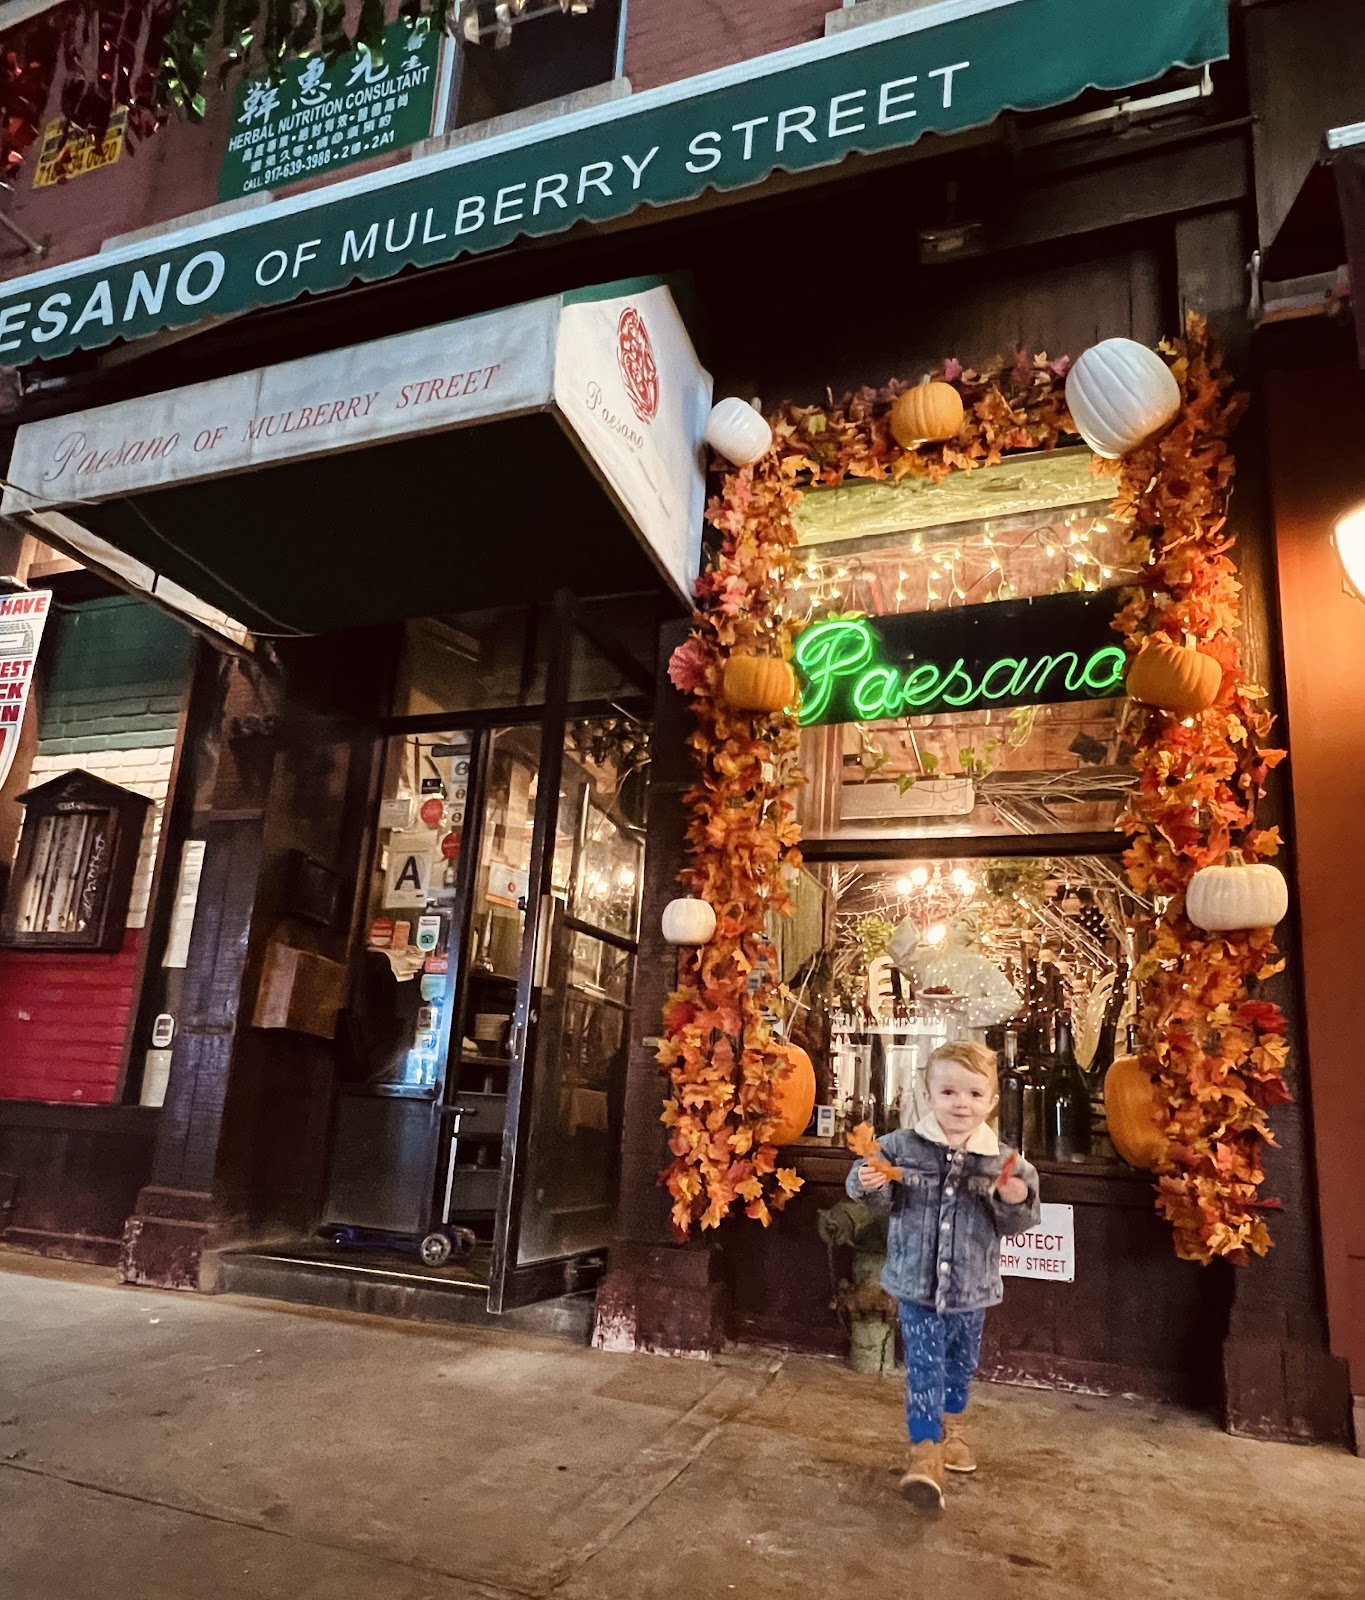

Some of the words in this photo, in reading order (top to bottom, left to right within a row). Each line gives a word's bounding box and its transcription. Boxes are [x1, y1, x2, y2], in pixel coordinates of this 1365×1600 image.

[228, 123, 275, 151] HERBAL
[277, 100, 344, 134] NUTRITION
[345, 66, 431, 111] CONSULTANT
[264, 149, 331, 185] 917-639-3988
[371, 129, 395, 149] 2A1
[0, 250, 226, 352] ESANO
[254, 239, 321, 287] OF
[339, 146, 660, 266] MULBERRY
[685, 61, 970, 174] STREET
[43, 430, 180, 482] Paesano
[193, 426, 227, 453] OF
[242, 391, 379, 442] MULBERRY
[395, 364, 501, 410] STREET
[586, 381, 644, 448] Paesano
[0, 660, 32, 677] EST
[796, 620, 1126, 725] Paesano
[394, 856, 421, 891] A
[1026, 1257, 1066, 1273] STREET
